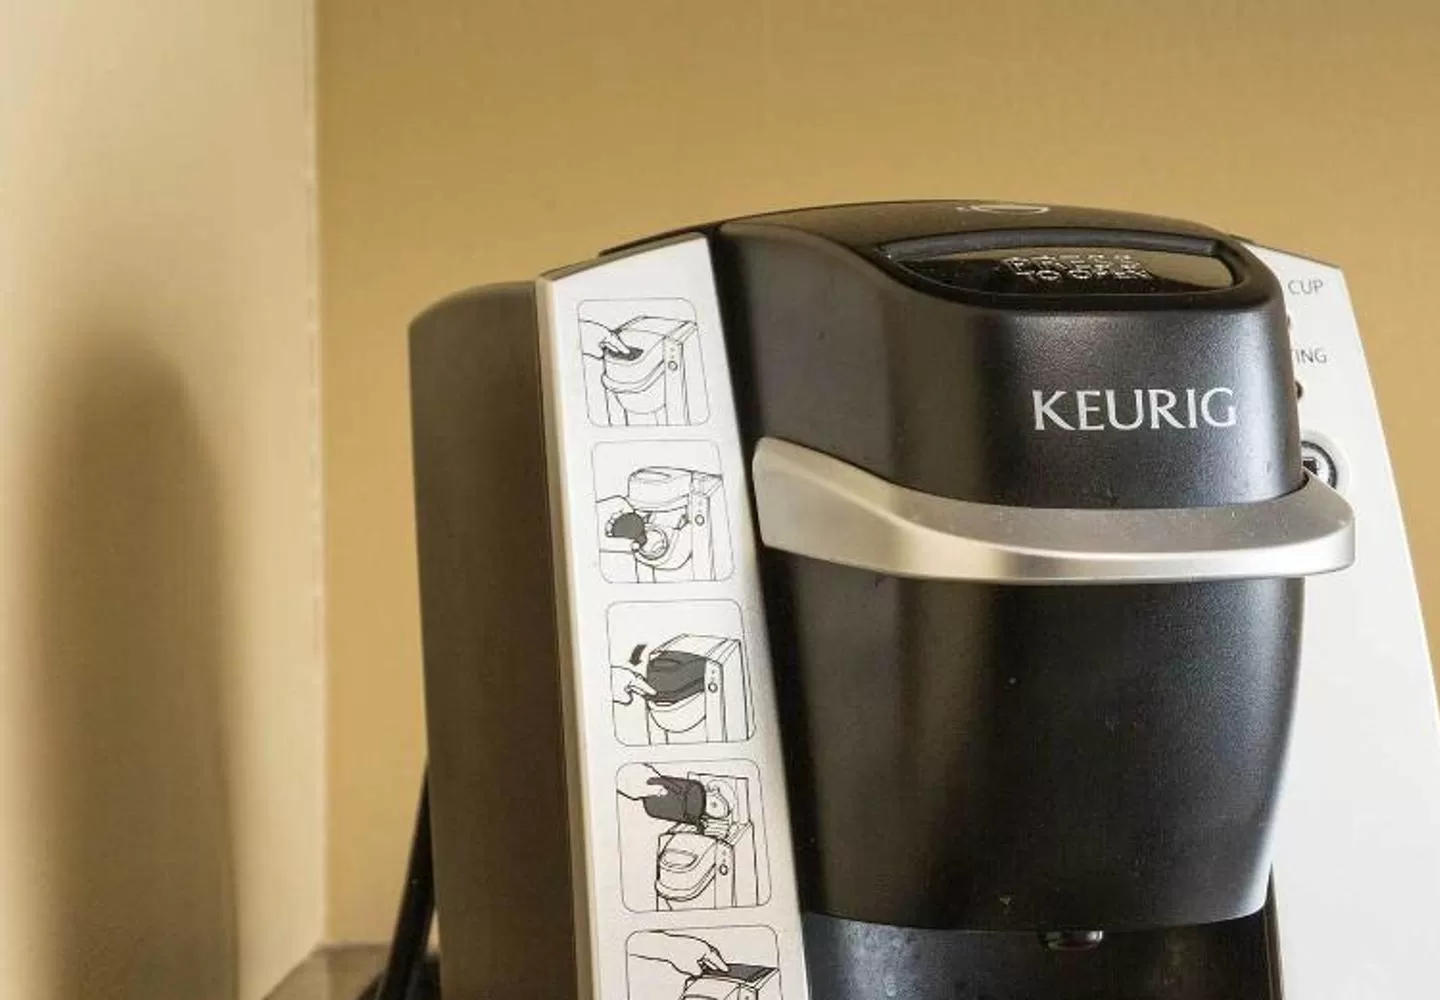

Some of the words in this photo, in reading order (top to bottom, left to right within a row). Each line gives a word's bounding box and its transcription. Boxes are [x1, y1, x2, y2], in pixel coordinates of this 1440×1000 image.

[1287, 278, 1324, 296] CUP
[1292, 346, 1328, 364] ING
[1032, 386, 1239, 431] KEURIG
